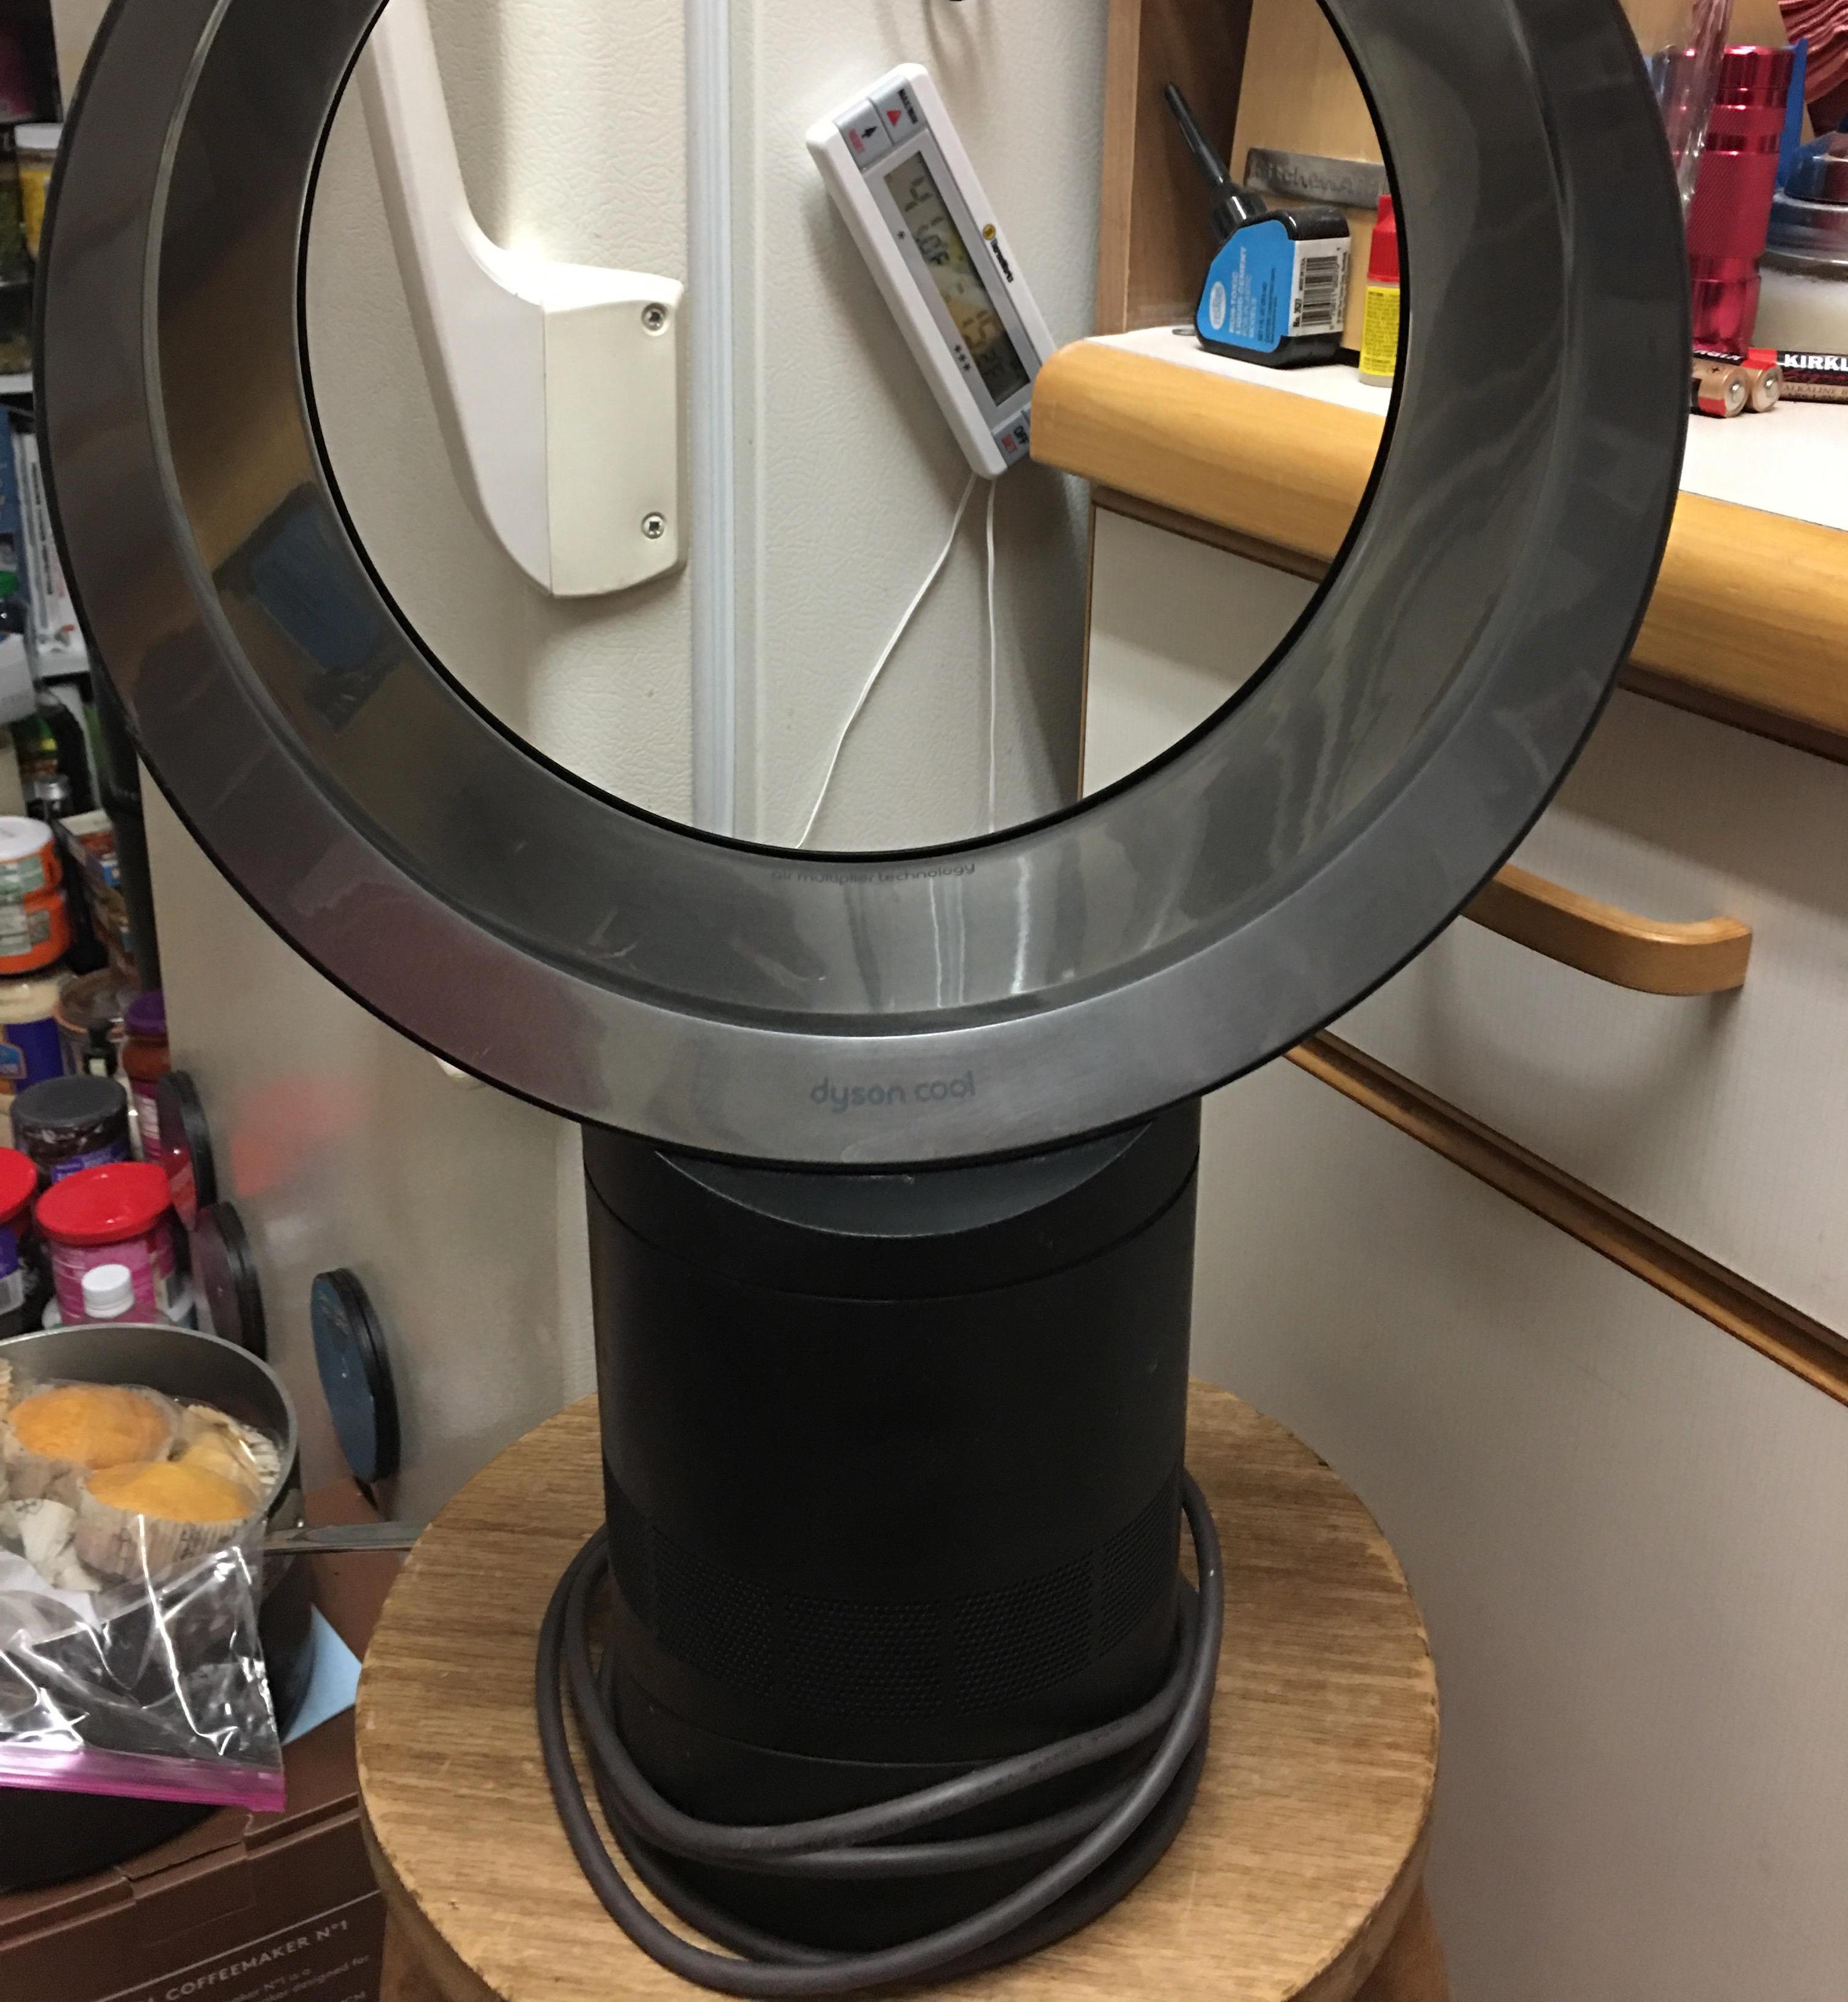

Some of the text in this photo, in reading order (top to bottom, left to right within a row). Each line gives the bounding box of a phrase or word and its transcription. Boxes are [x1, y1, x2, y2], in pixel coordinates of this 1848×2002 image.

[1238, 246, 1247, 295] CEMENT
[878, 862, 976, 882] technology
[810, 1070, 976, 1115] dyson cool
[165, 1935, 311, 2001] COFFEEMAKER
